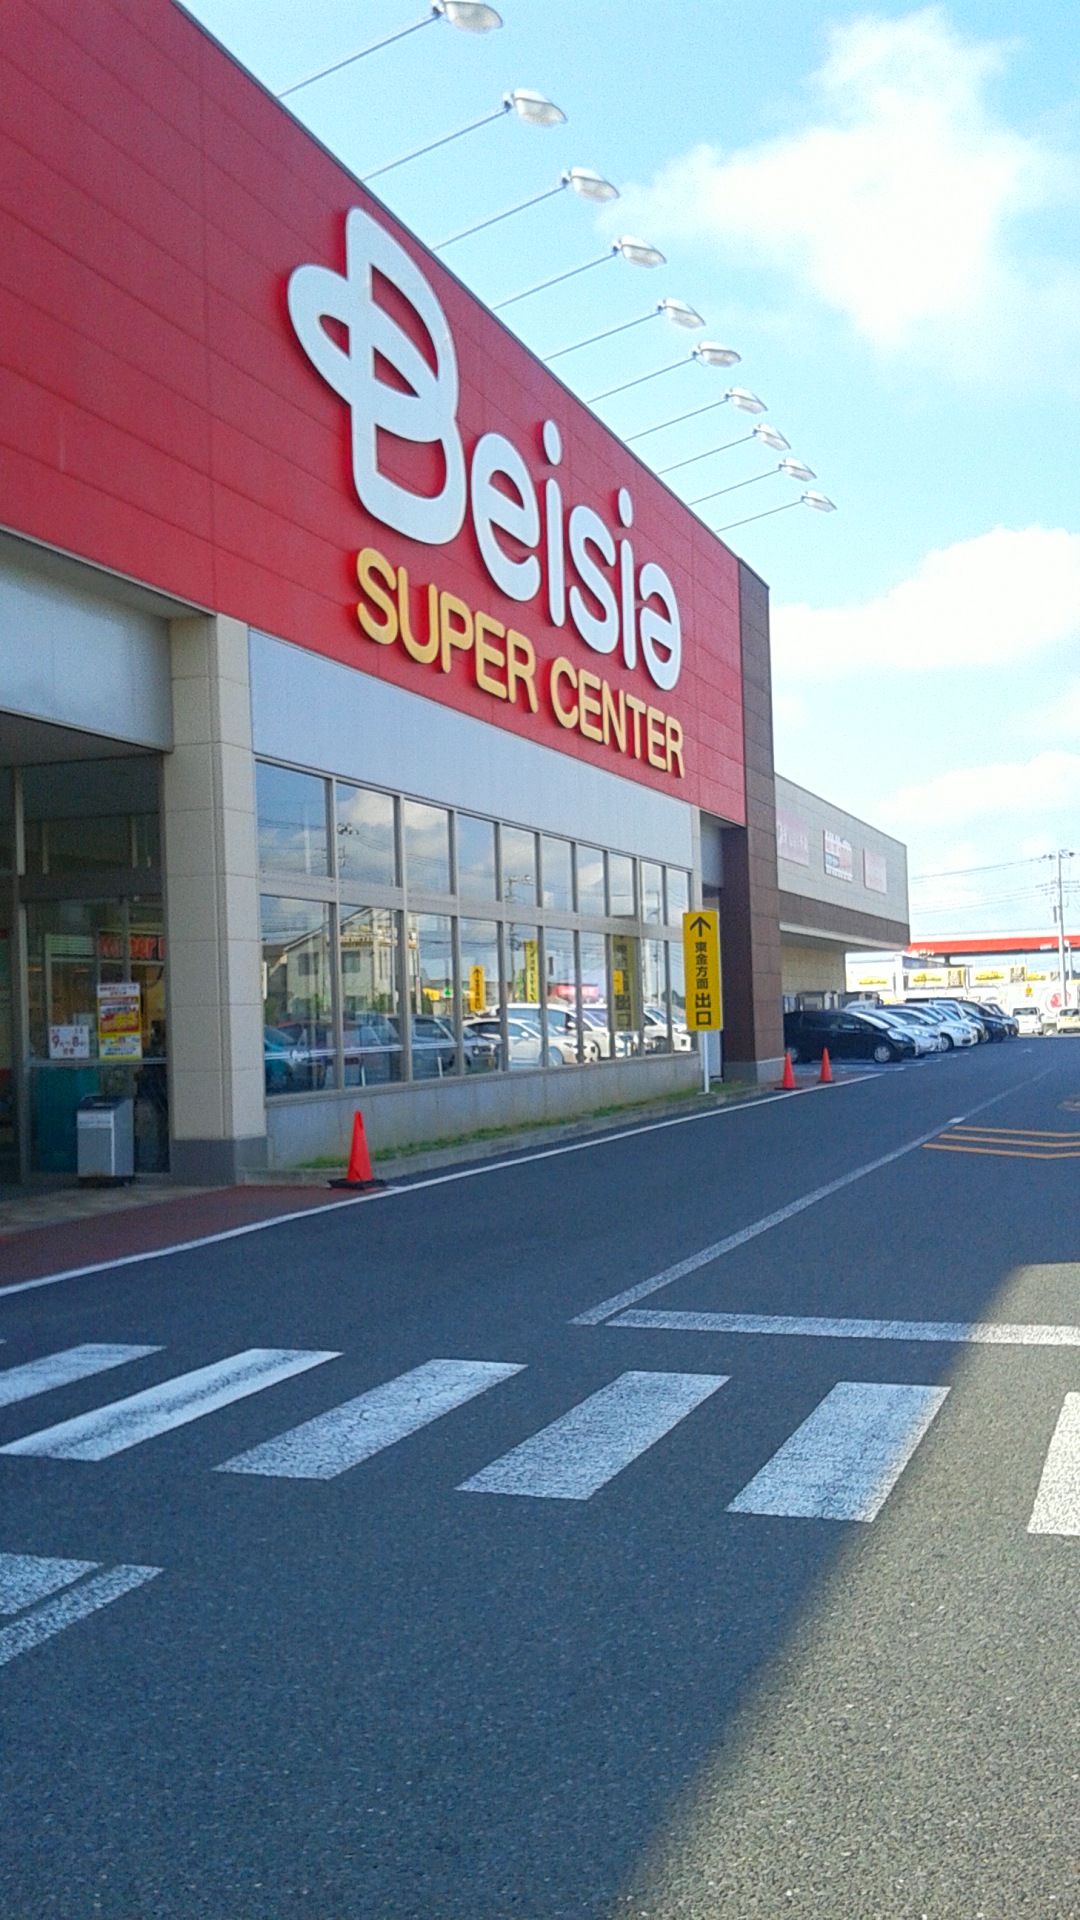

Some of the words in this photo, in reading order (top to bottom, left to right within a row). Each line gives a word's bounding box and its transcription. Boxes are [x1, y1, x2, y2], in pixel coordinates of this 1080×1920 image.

[286, 206, 682, 691] Beisia
[356, 547, 539, 713] SUPER
[549, 656, 685, 778] CENTER
